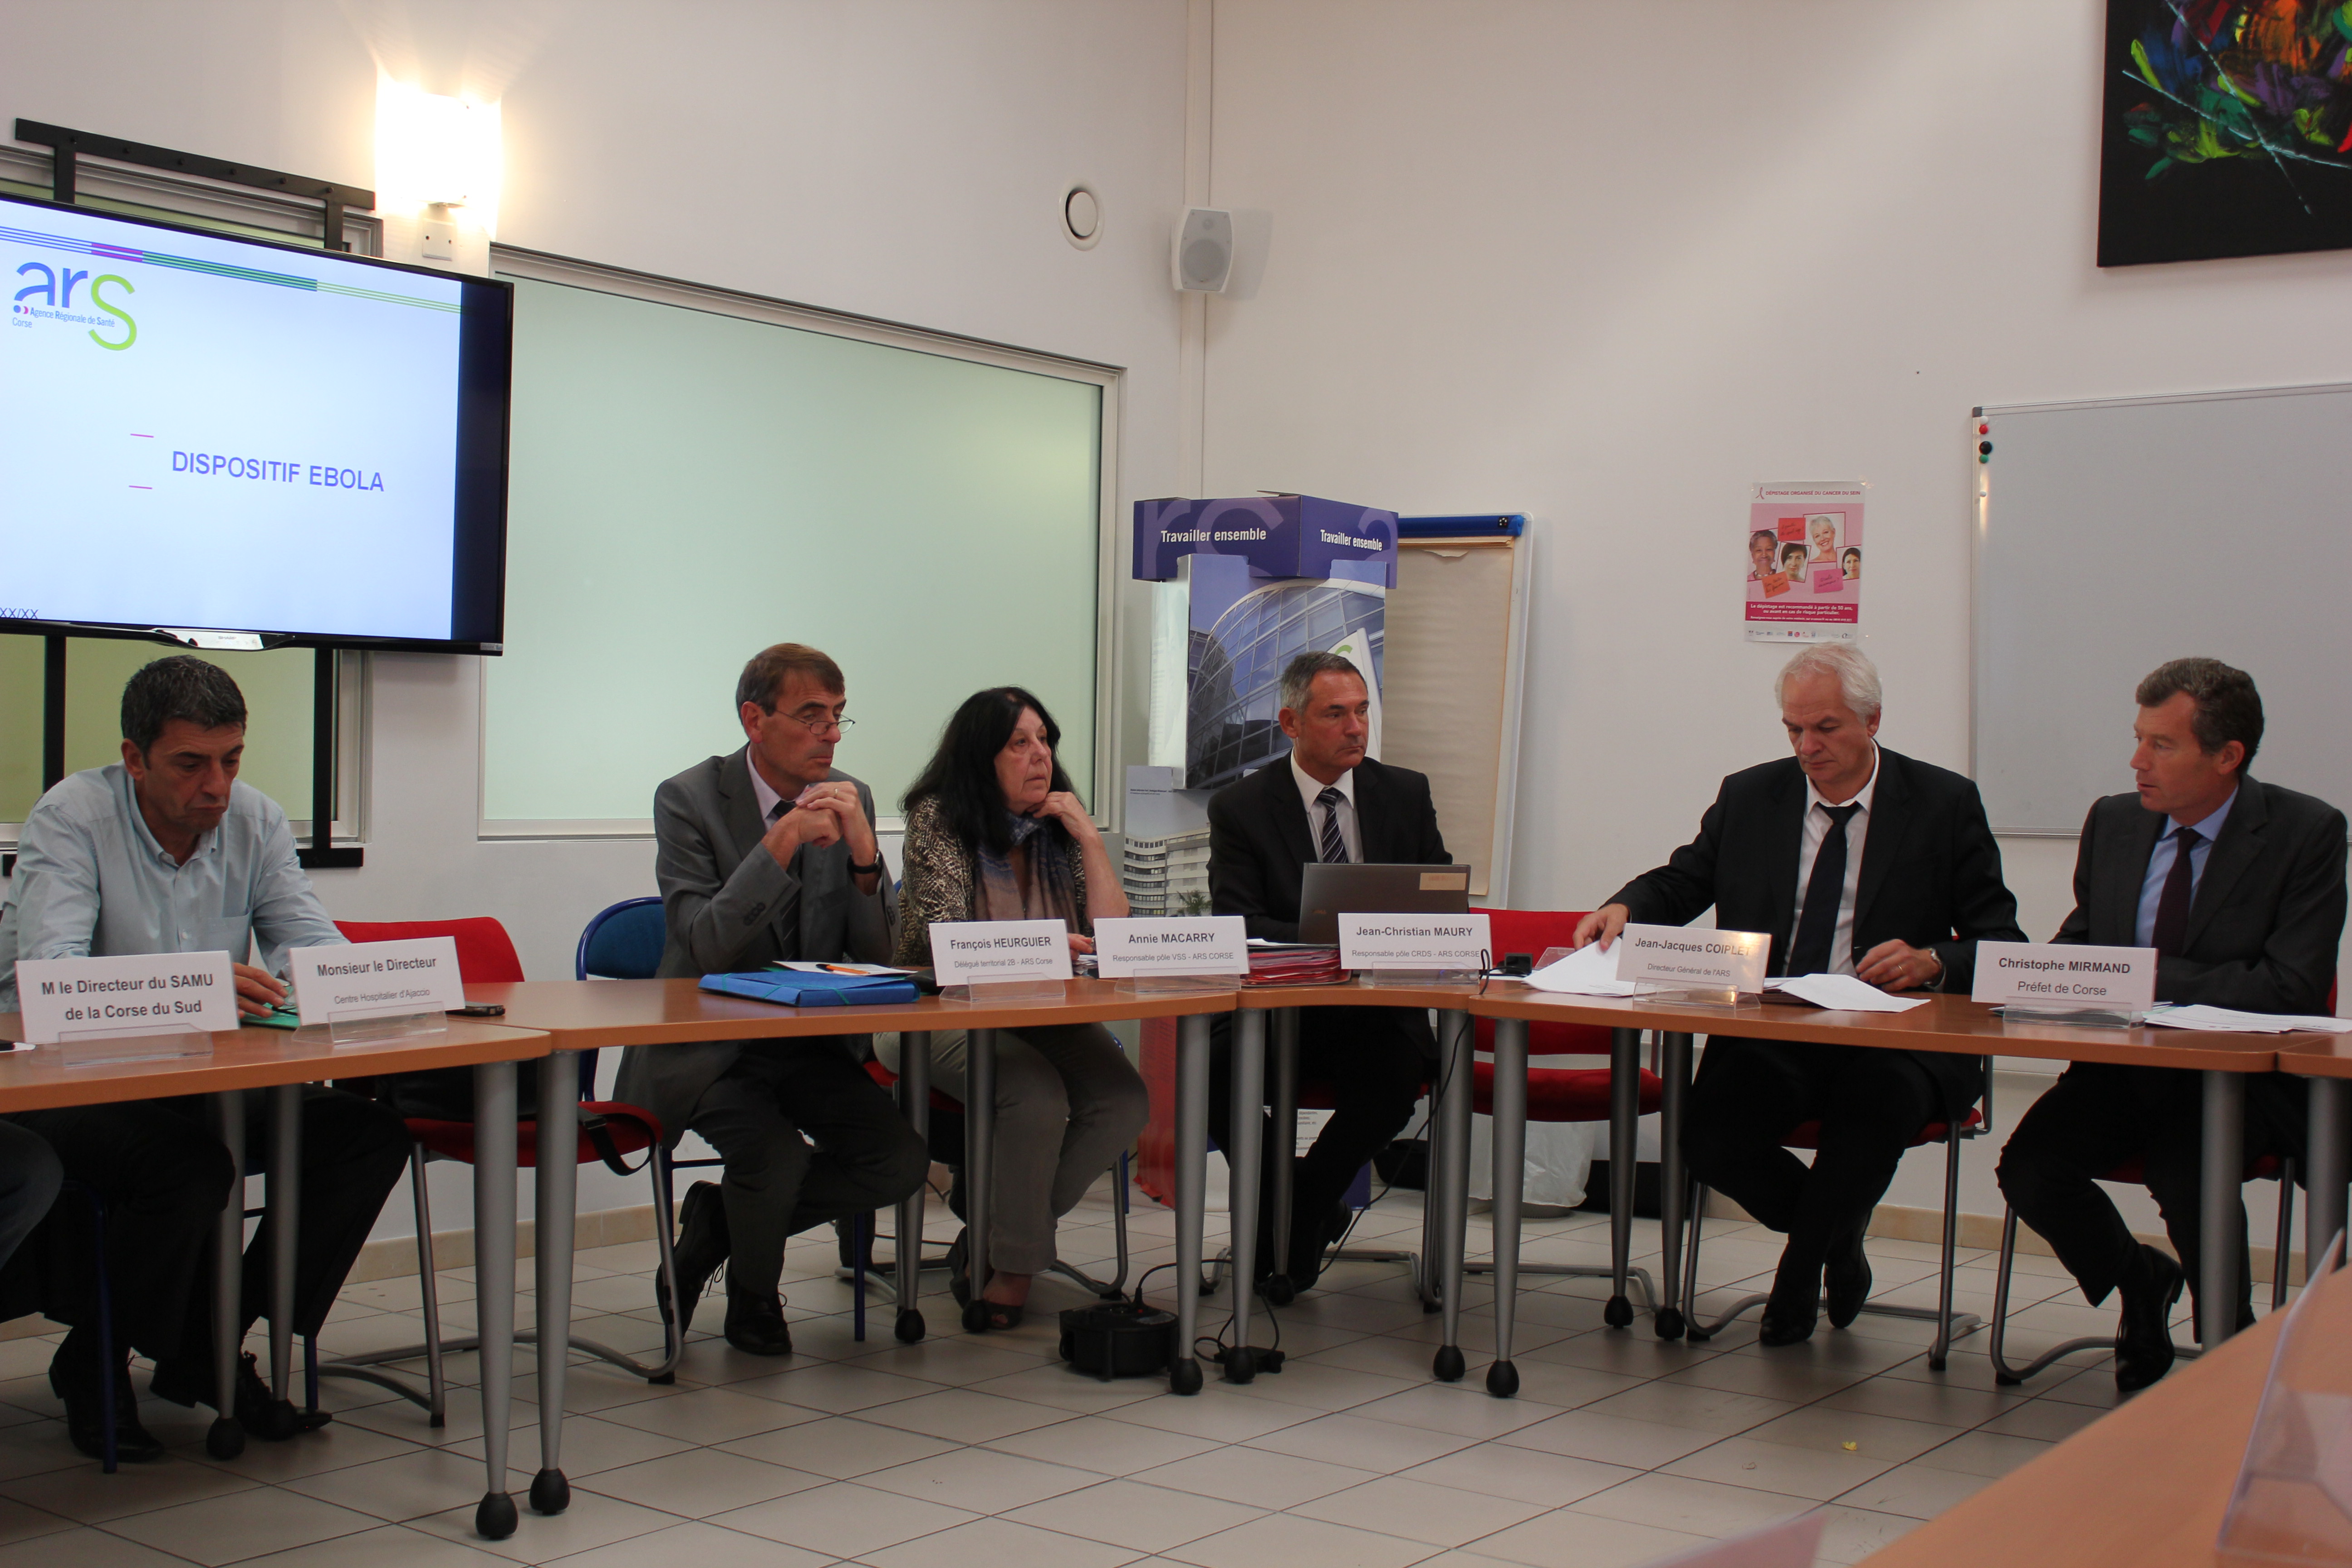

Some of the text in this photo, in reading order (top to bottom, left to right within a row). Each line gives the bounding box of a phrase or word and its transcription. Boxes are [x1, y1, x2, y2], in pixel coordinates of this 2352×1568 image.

[14, 262, 137, 351] ars
[13, 317, 32, 328] Corse
[30, 307, 115, 327] Agence Régionale de Santé
[173, 451, 384, 491] DISPOSITIF EBOLA
[1161, 528, 1266, 543] Travailler ensemble
[1320, 529, 1382, 551] Travailler ensemble
[1129, 933, 1215, 944] Annie MACARRY
[1357, 927, 1472, 936] Jean-Christian MAURY
[951, 936, 1052, 951] François HEURGUIER
[1635, 938, 1751, 956] Jean-Jacques COIPLET
[1352, 950, 1394, 958] Responsable
[318, 957, 436, 976] Monsieur le Directeur
[955, 960, 979, 969] Délégué
[1647, 963, 1675, 972] Directeur
[1677, 965, 1701, 975] Général
[1999, 958, 2130, 973] Christophe MIRMAND
[42, 974, 213, 995] M le Directeur du SAMU
[2018, 981, 2107, 995] Préfet de Corse
[334, 989, 430, 1004] Centre Hospitalier d'Ajaccio
[66, 1000, 202, 1020] de la Corse du Sud
